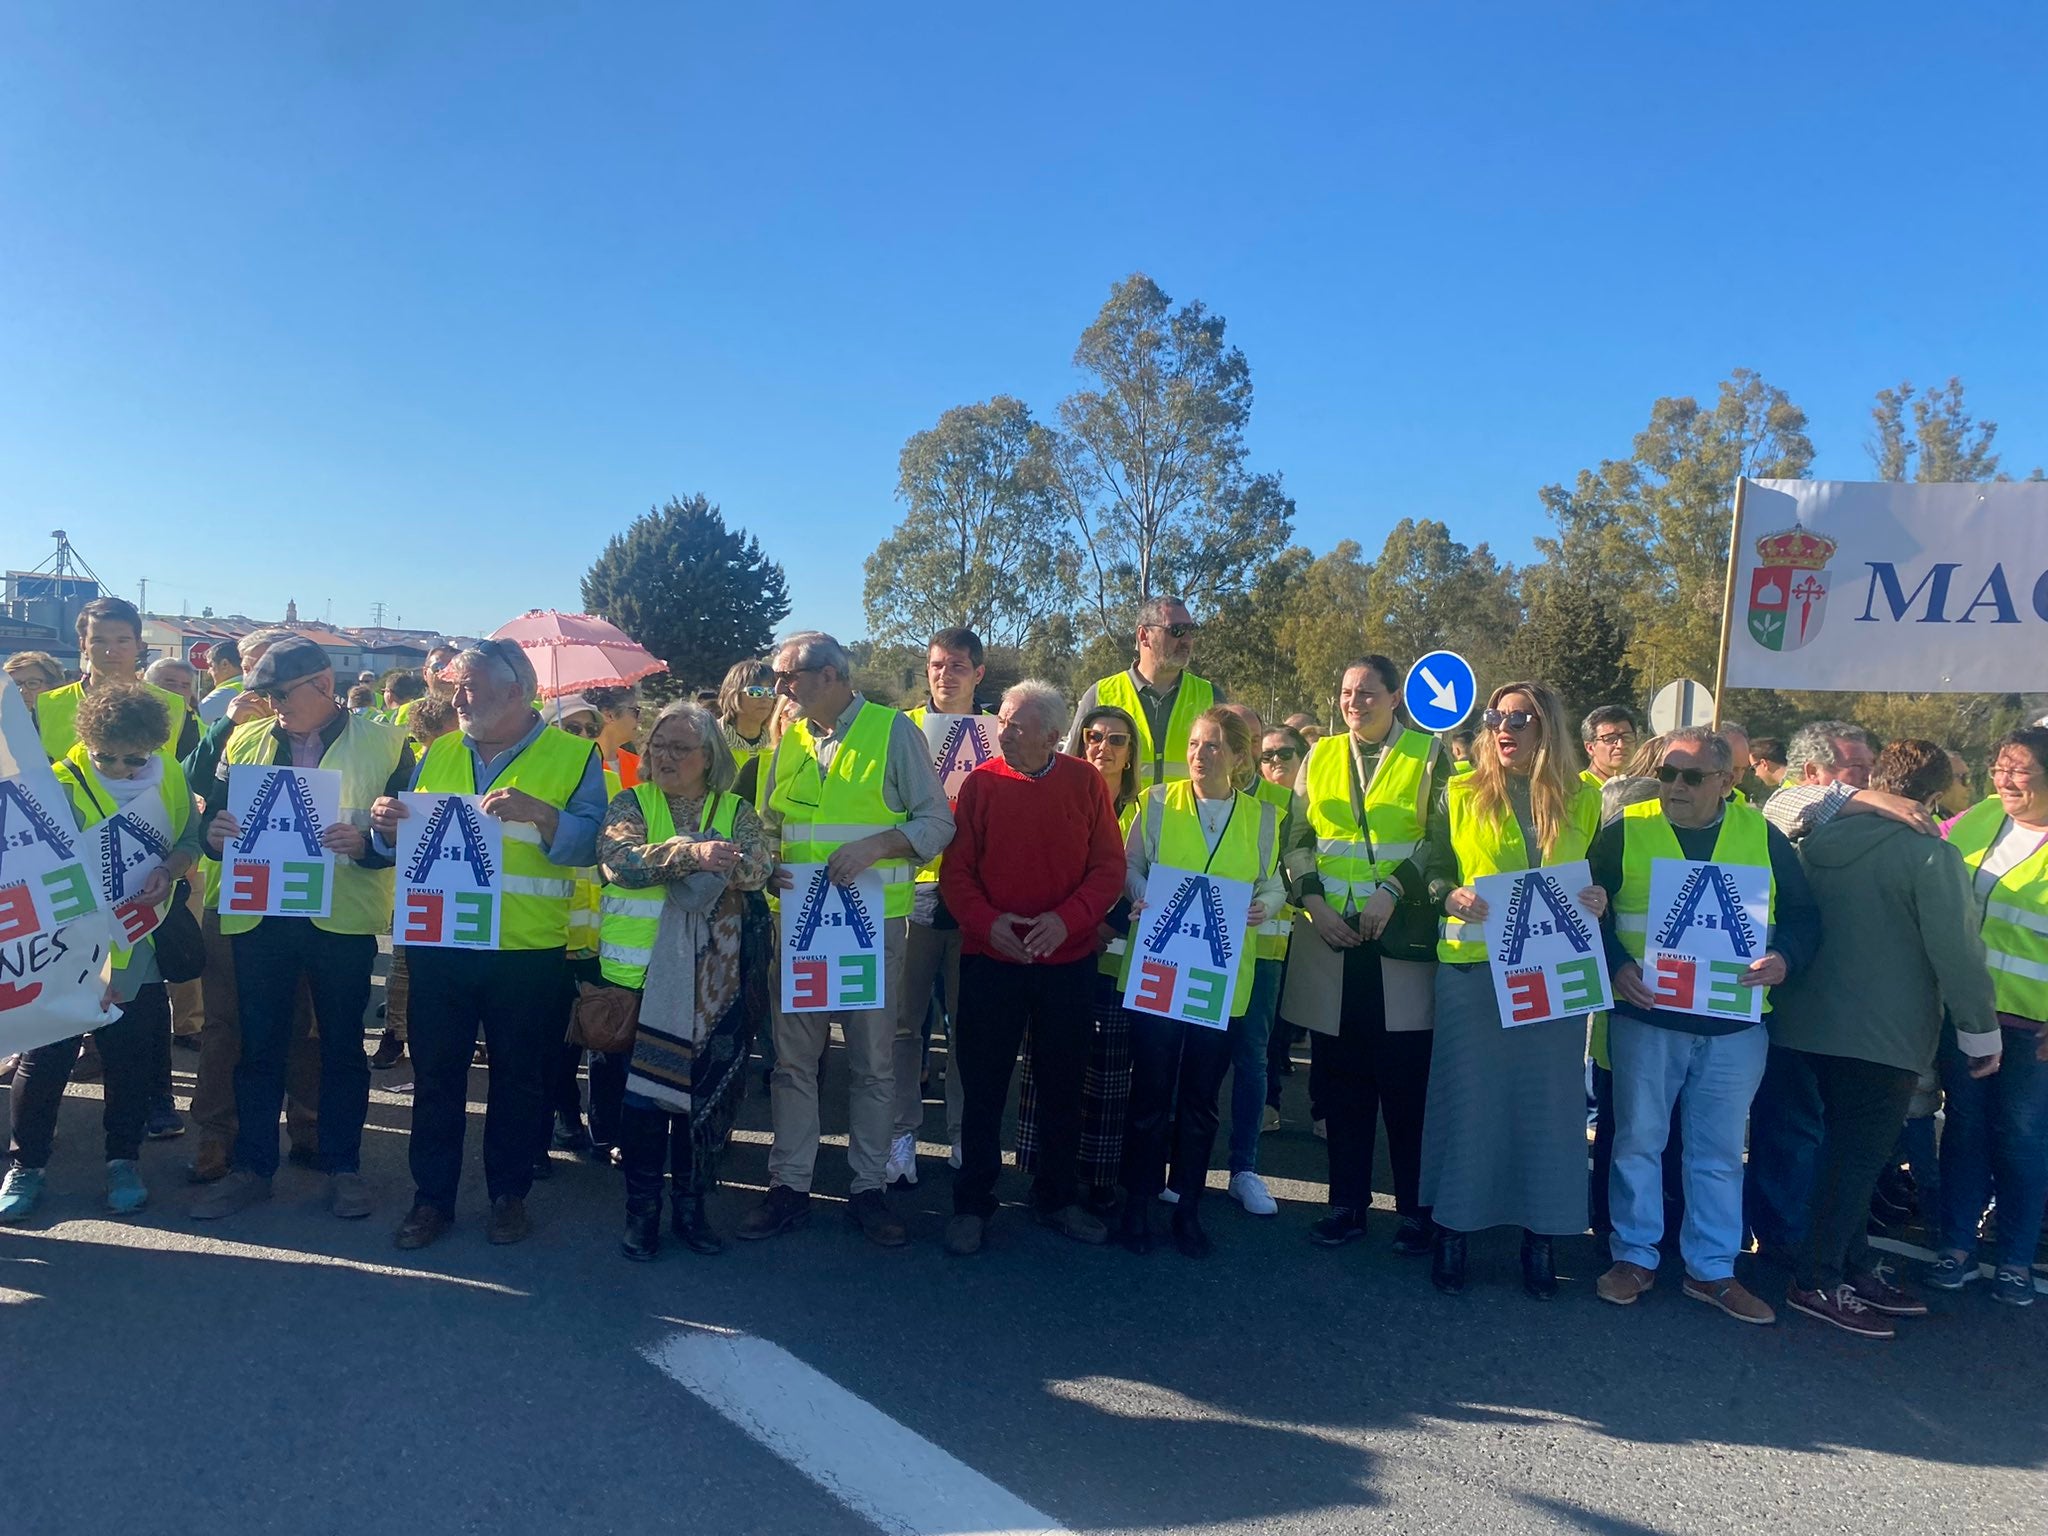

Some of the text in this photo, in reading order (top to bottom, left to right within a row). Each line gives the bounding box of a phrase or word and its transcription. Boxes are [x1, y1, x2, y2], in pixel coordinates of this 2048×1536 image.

[1854, 561, 2048, 624] MA
[934, 719, 961, 772] TAFORMA
[18, 783, 75, 849] CIUDADANA
[232, 771, 277, 850] PLATAFORMA
[404, 799, 448, 879] PLATAFORMA
[465, 803, 495, 879] CIUDADANA
[101, 825, 112, 902] PLATAFORMA
[789, 868, 824, 948] PLATAFORMA
[847, 882, 877, 940] UDADANA
[1143, 876, 1194, 948] PLATAFORMA
[1211, 885, 1233, 960] CIUDADANA
[1498, 877, 1525, 962] PLATAFORMA
[1546, 876, 1593, 943] CIUDADANA
[1655, 866, 1702, 944] PLATAFORMA
[1723, 873, 1757, 949] CIUDADANA
